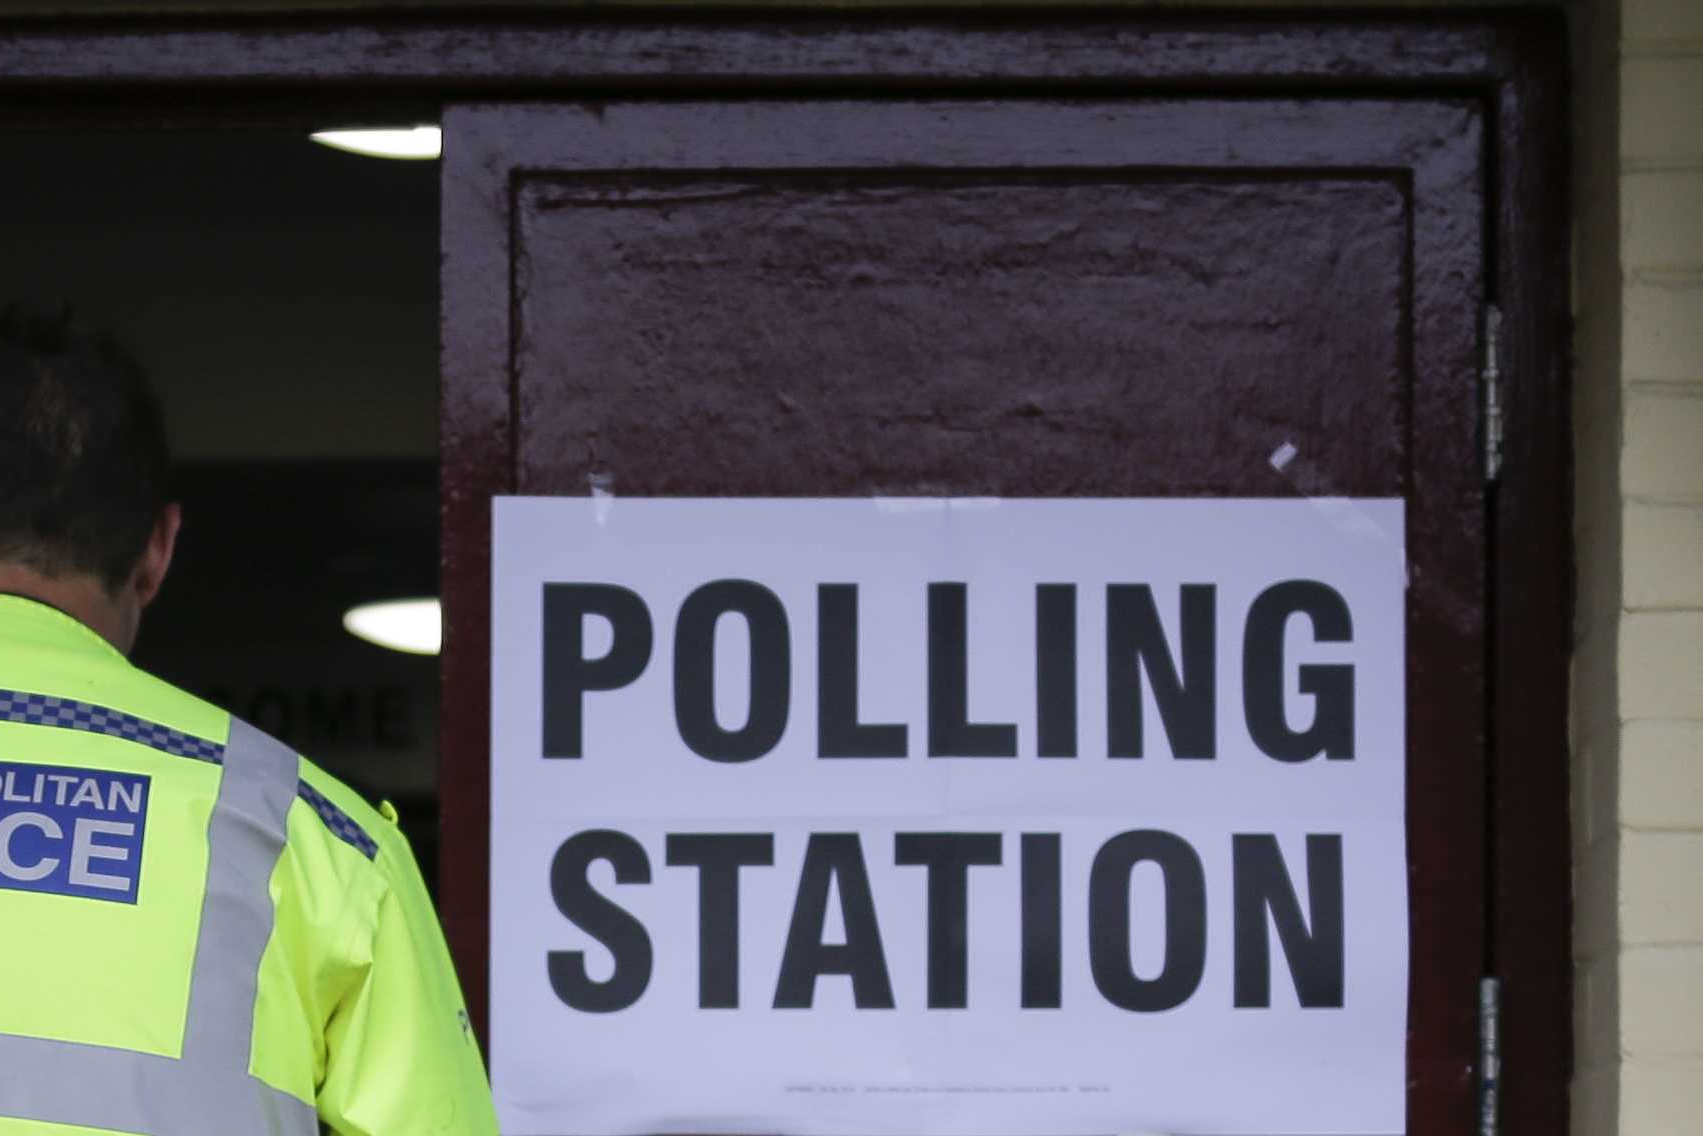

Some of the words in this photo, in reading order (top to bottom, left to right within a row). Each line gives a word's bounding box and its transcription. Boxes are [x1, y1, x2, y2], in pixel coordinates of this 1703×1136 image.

[201, 684, 412, 748] OME
[541, 578, 1356, 764] POLLING
[547, 828, 1345, 1014] STATION
